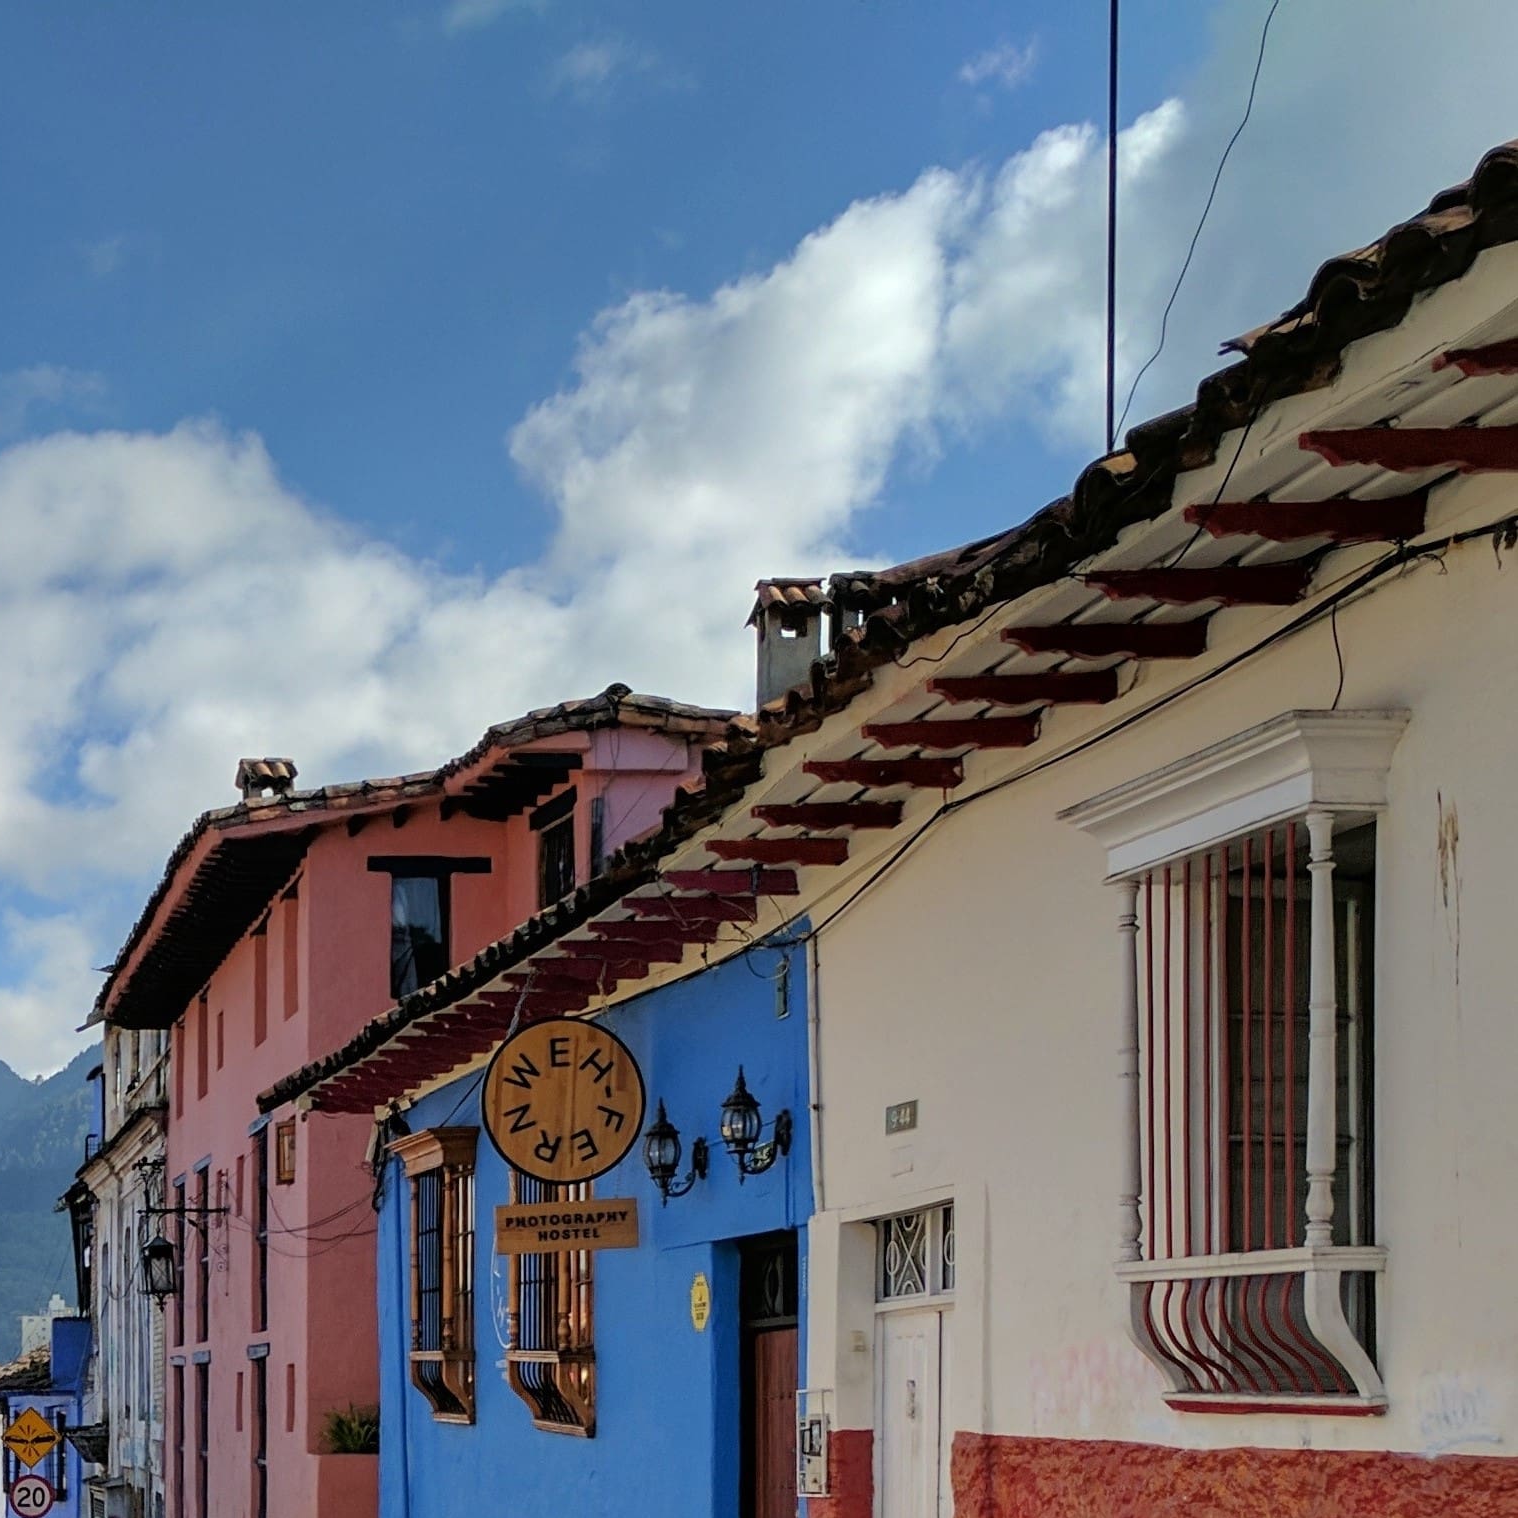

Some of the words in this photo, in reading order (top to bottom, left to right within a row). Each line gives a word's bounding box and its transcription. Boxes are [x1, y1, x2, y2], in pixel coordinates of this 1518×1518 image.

[505, 1210, 628, 1228] PHOTOGRAPHY
[538, 1228, 601, 1241] HOSTEL
[17, 1486, 45, 1507] 20
